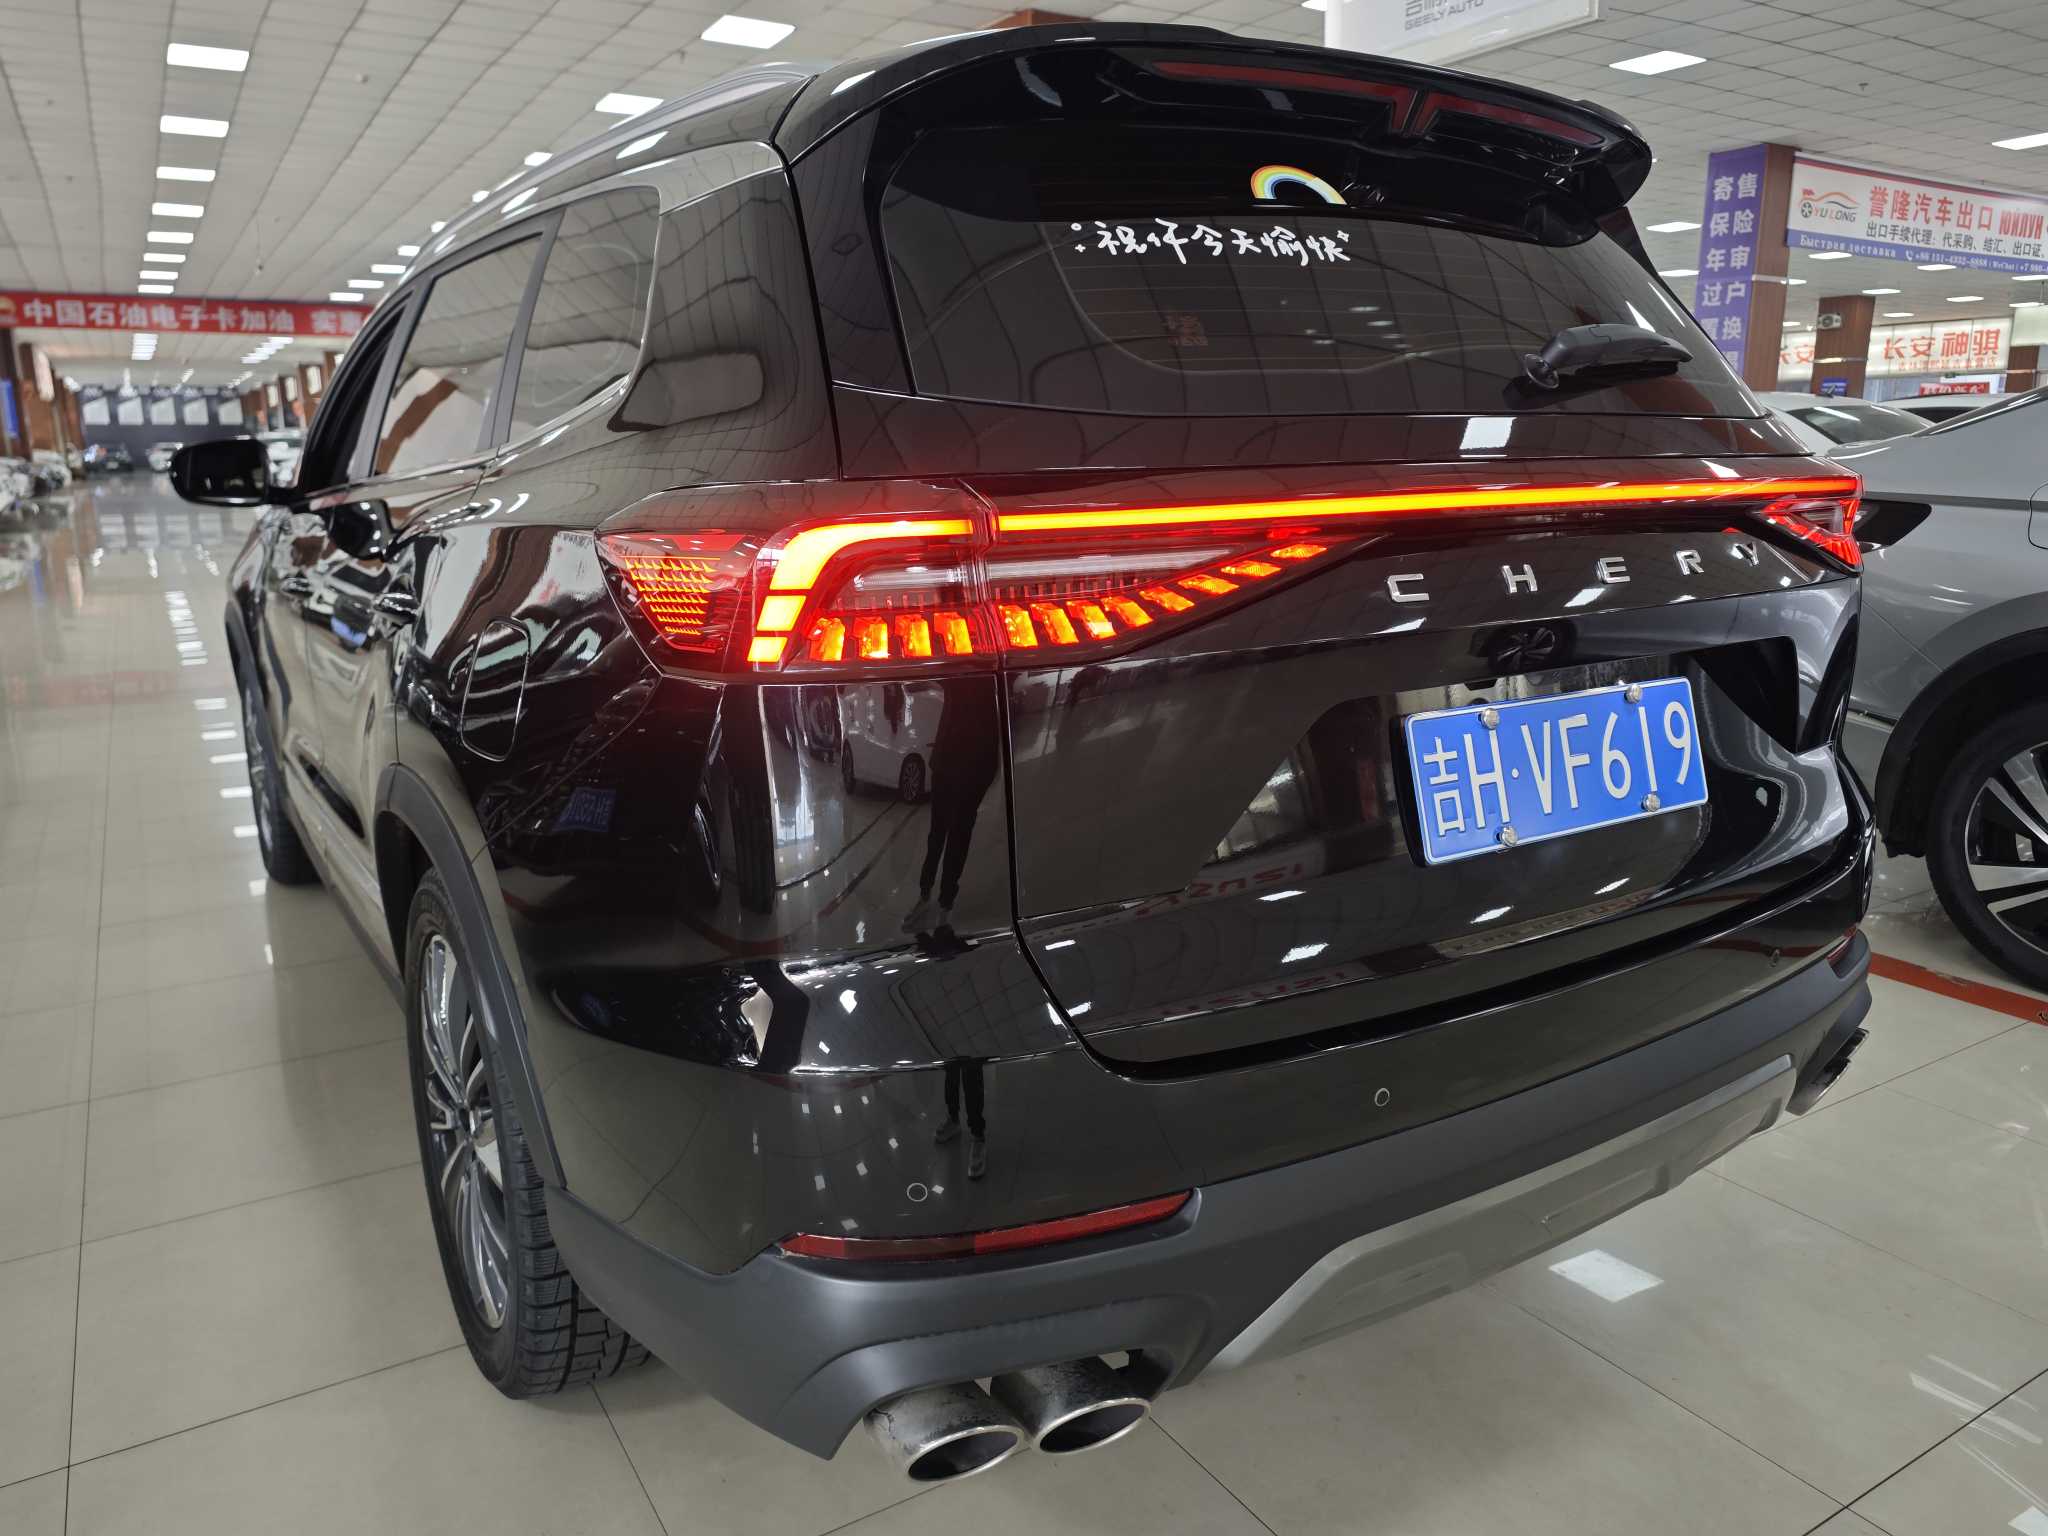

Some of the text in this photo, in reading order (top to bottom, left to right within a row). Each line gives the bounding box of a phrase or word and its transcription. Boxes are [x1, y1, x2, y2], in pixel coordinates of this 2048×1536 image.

[1404, 8, 1448, 31] GEELY
[1447, 0, 1485, 17] AUTO
[1712, 172, 1759, 202] 寄售
[1709, 208, 1756, 239] 保险
[1868, 185, 1994, 231] 誉隆汽车出口
[1706, 244, 1751, 273] 年审
[1701, 281, 1747, 307] 过户
[23, 298, 295, 333] 中国石油电子卡加油
[1386, 542, 1763, 604] CHERY
